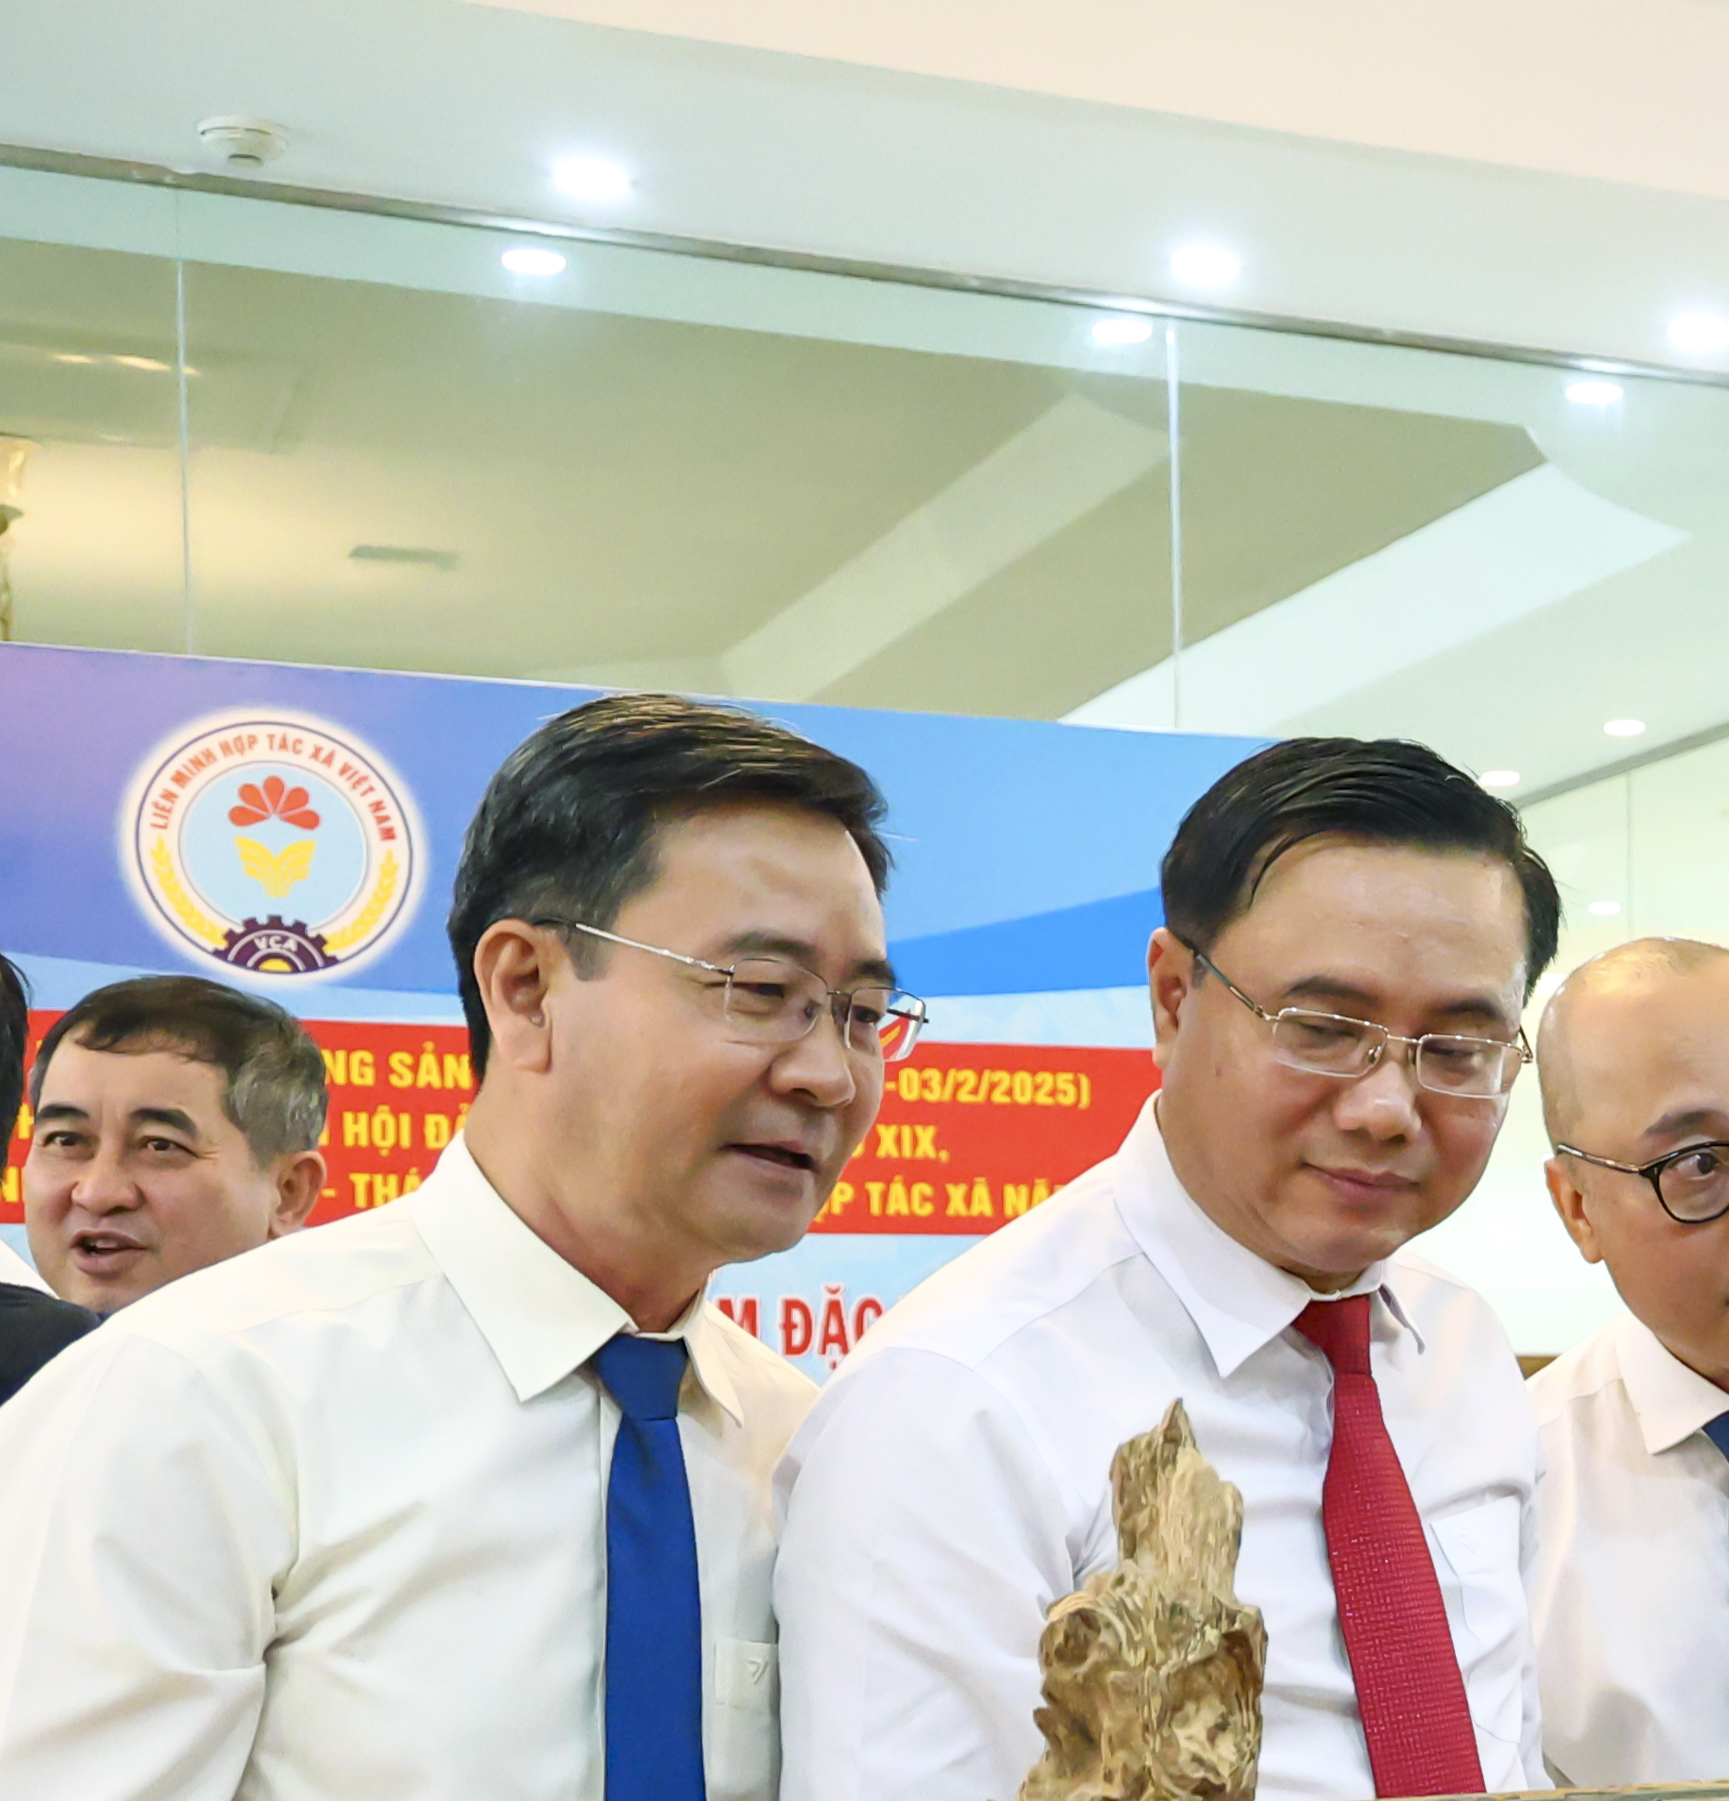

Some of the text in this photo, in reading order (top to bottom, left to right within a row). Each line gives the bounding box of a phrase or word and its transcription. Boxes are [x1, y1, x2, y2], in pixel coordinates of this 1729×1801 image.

[151, 732, 397, 841] LIÊN MINH HỢP TÁC XÃ VIỆT NAM
[253, 935, 298, 951] VCA
[321, 1041, 473, 1089] NG SẢN
[885, 1067, 1092, 1110] -03/2/2025)
[343, 1105, 412, 1159] HỘI
[875, 1123, 950, 1163] XIX,
[864, 1174, 936, 1218] TÁC
[945, 1177, 994, 1218] XÃ
[1003, 1178, 1062, 1218] NĂ
